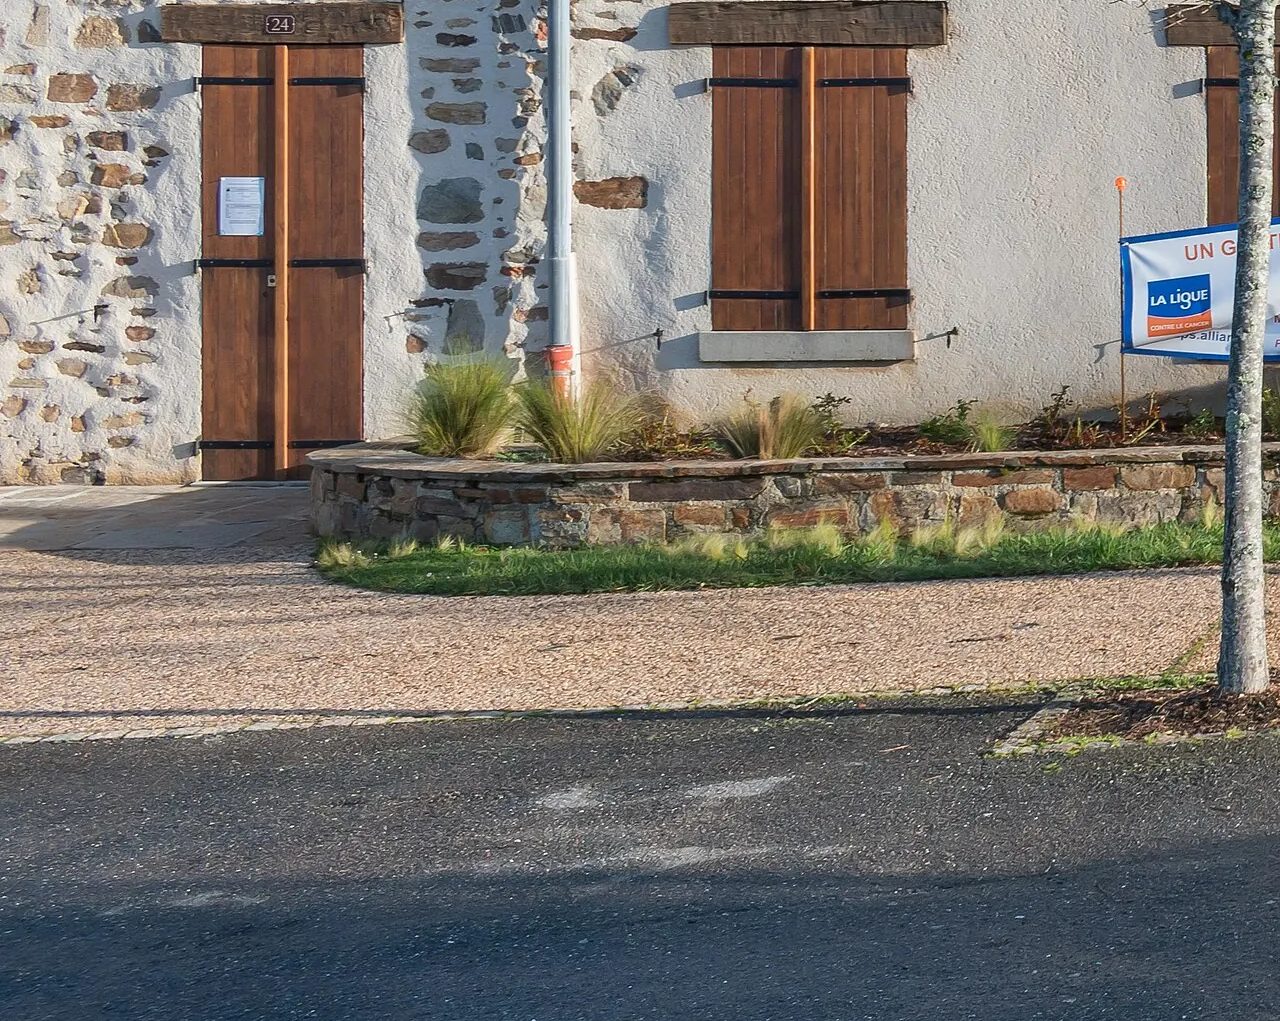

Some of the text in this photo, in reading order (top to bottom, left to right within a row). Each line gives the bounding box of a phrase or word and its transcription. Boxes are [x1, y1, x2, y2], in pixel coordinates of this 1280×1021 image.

[271, 18, 289, 31] 24
[1185, 243, 1214, 260] UN
[1150, 295, 1167, 306] LA
